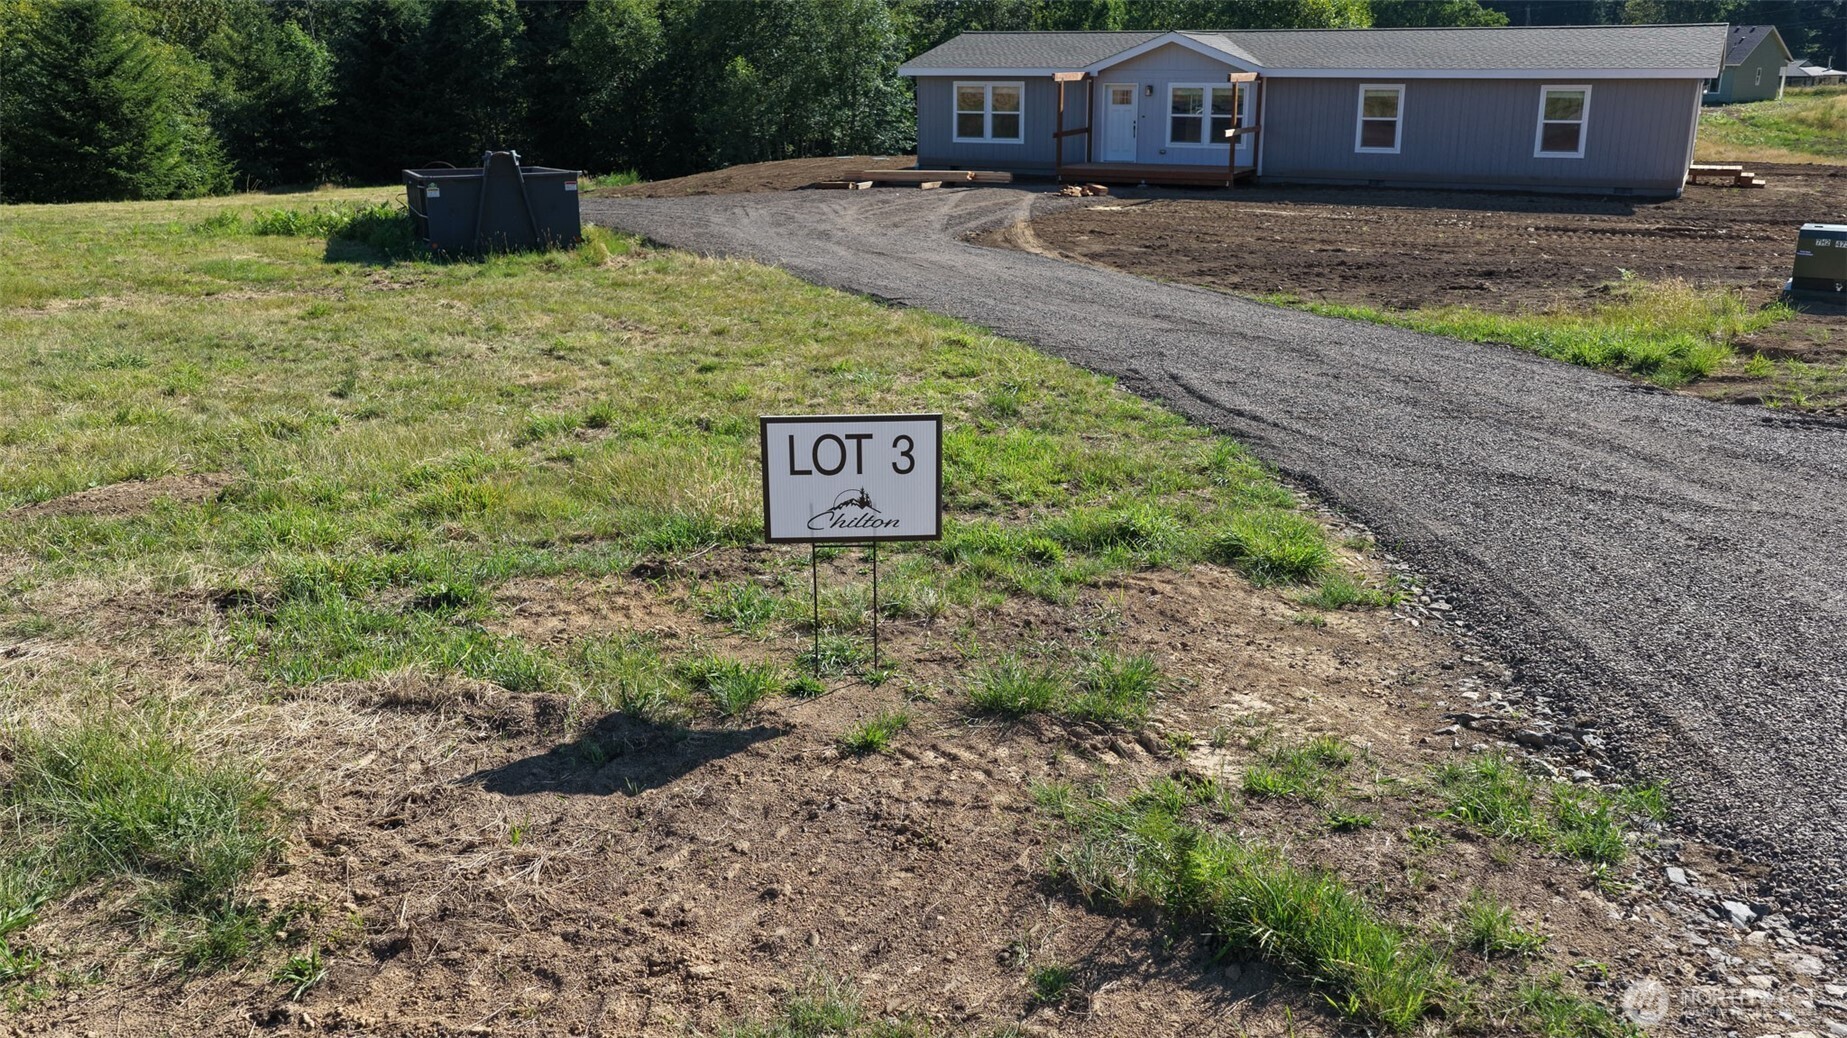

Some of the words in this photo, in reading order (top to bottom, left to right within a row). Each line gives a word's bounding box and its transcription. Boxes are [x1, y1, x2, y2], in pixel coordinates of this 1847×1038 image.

[788, 433, 873, 476] LOT
[891, 434, 915, 475] 3
[807, 511, 901, 531] Chilton
